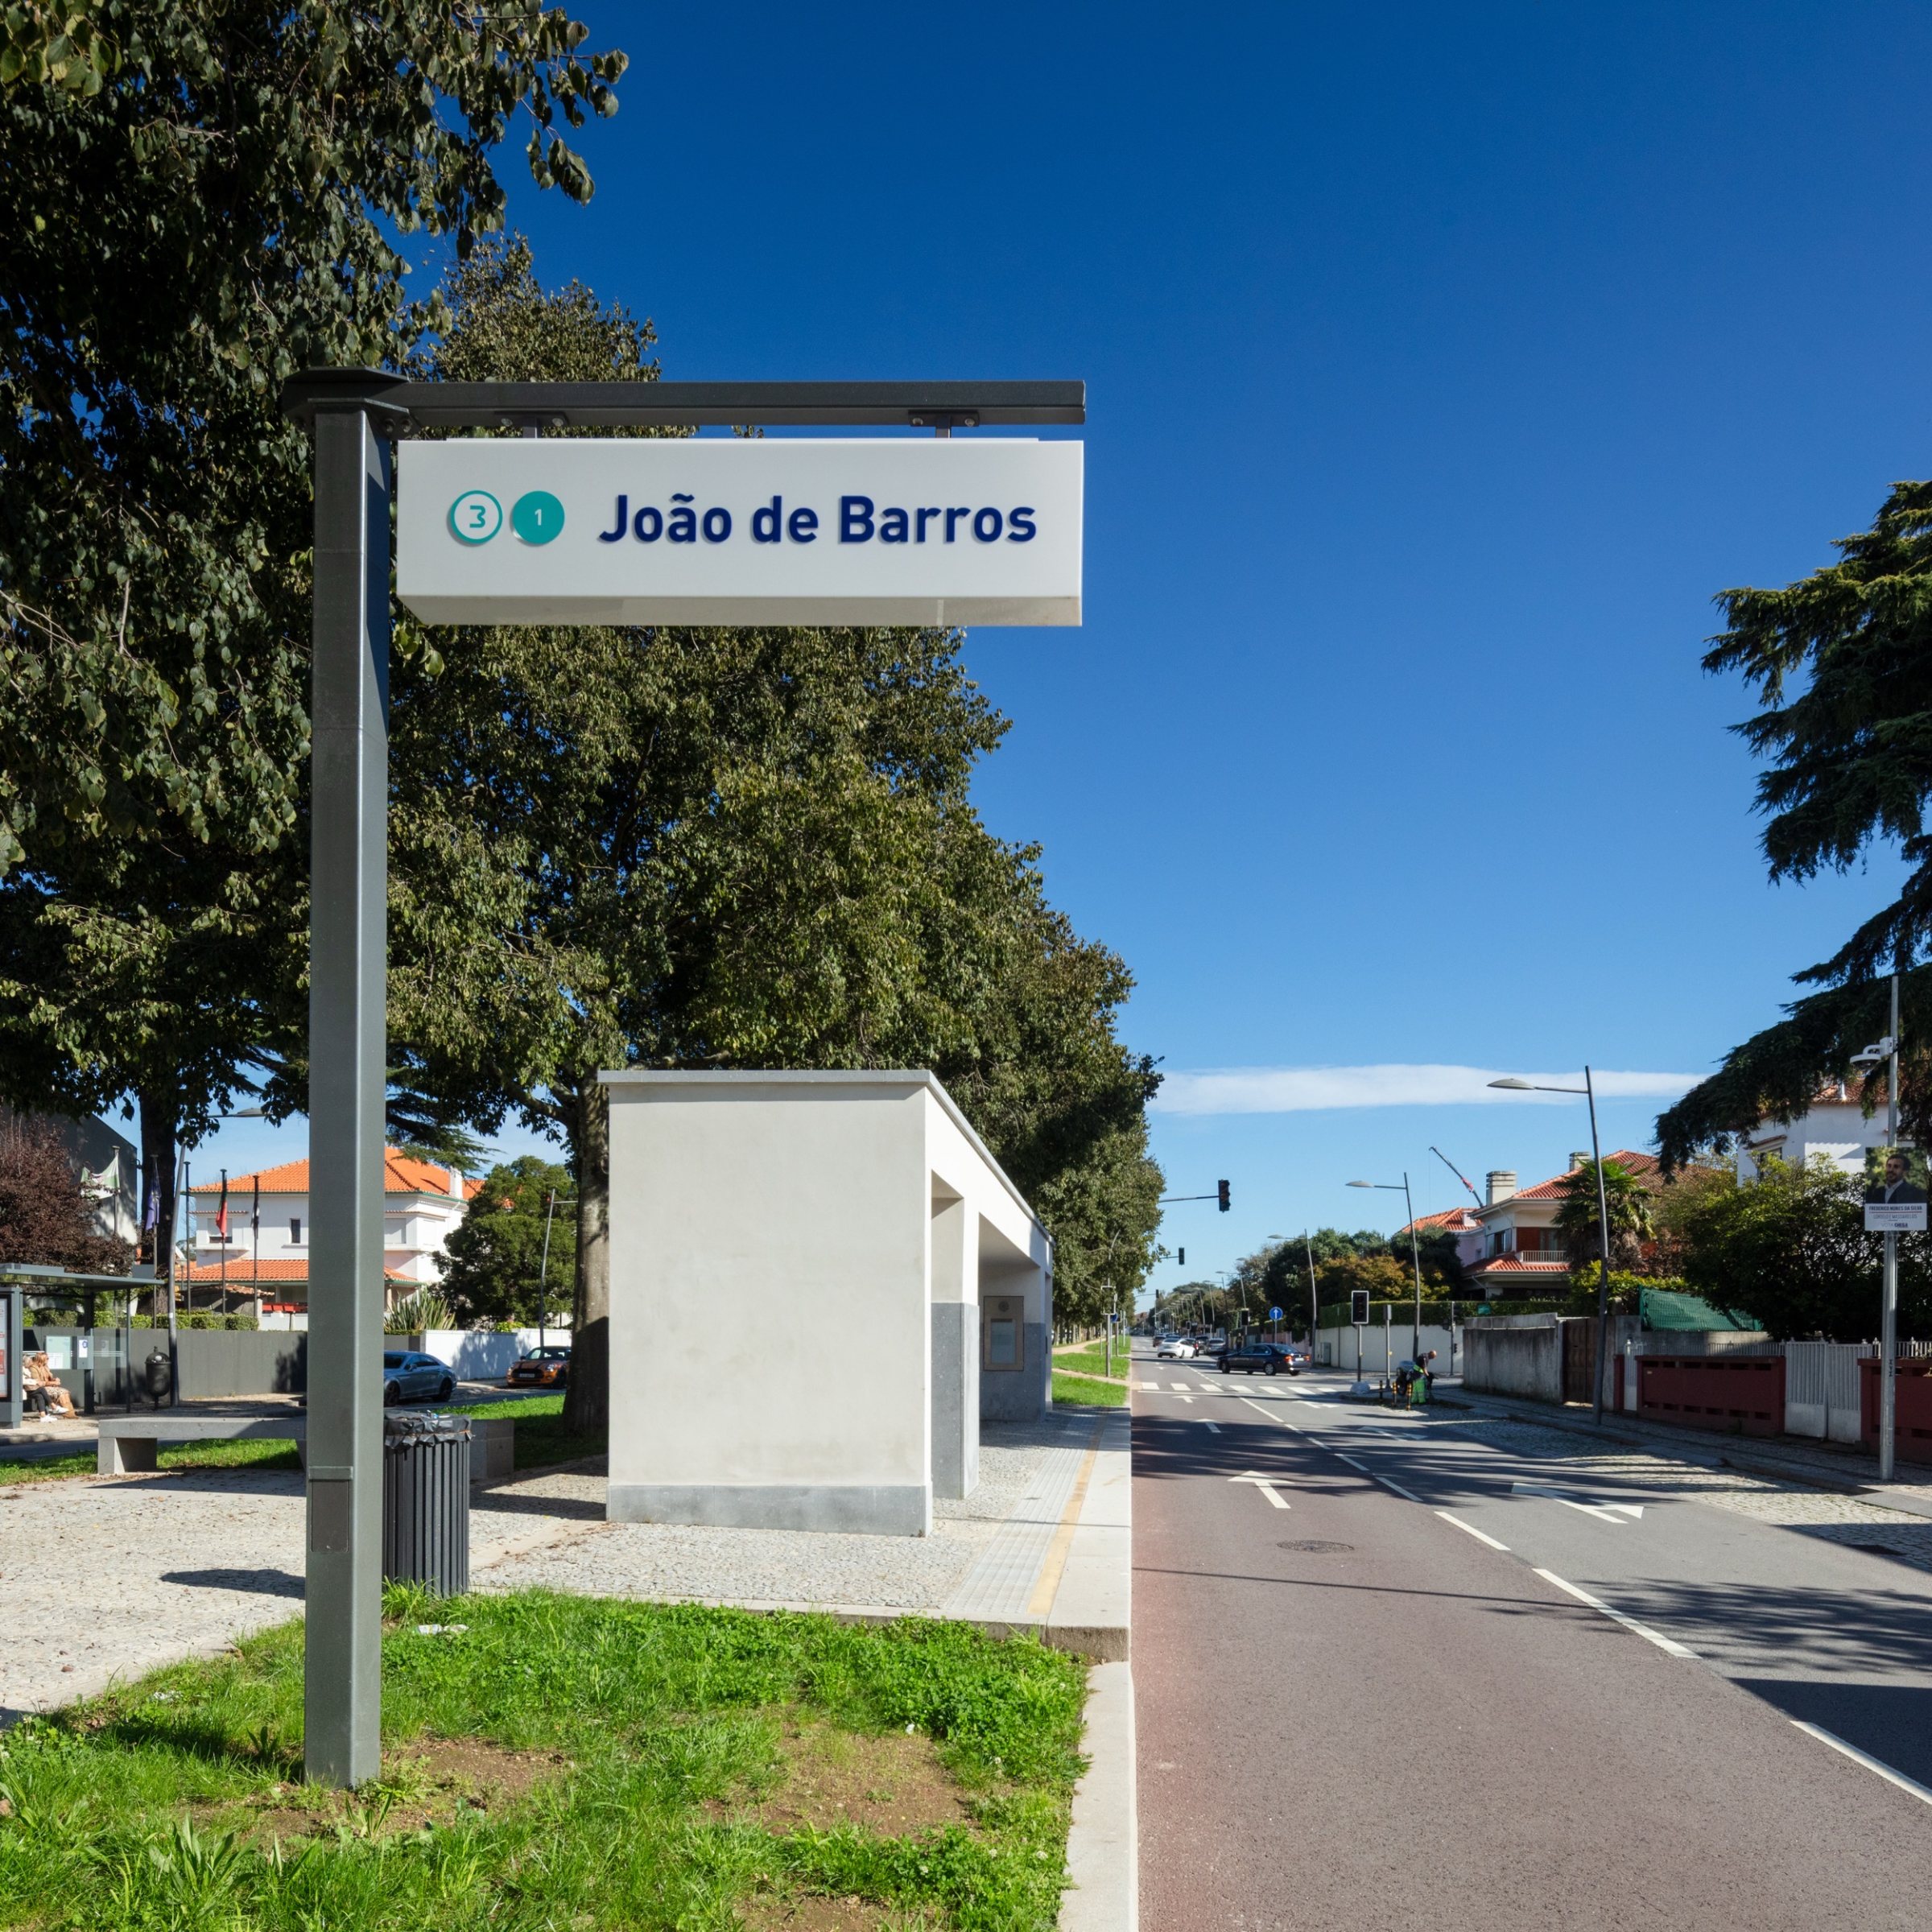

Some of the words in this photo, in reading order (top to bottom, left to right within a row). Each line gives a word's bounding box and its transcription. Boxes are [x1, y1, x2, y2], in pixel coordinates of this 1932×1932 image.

[469, 505, 486, 528] 3
[535, 508, 543, 526] 1
[599, 493, 732, 543] João
[752, 495, 819, 543] de
[840, 495, 1037, 543] Barros
